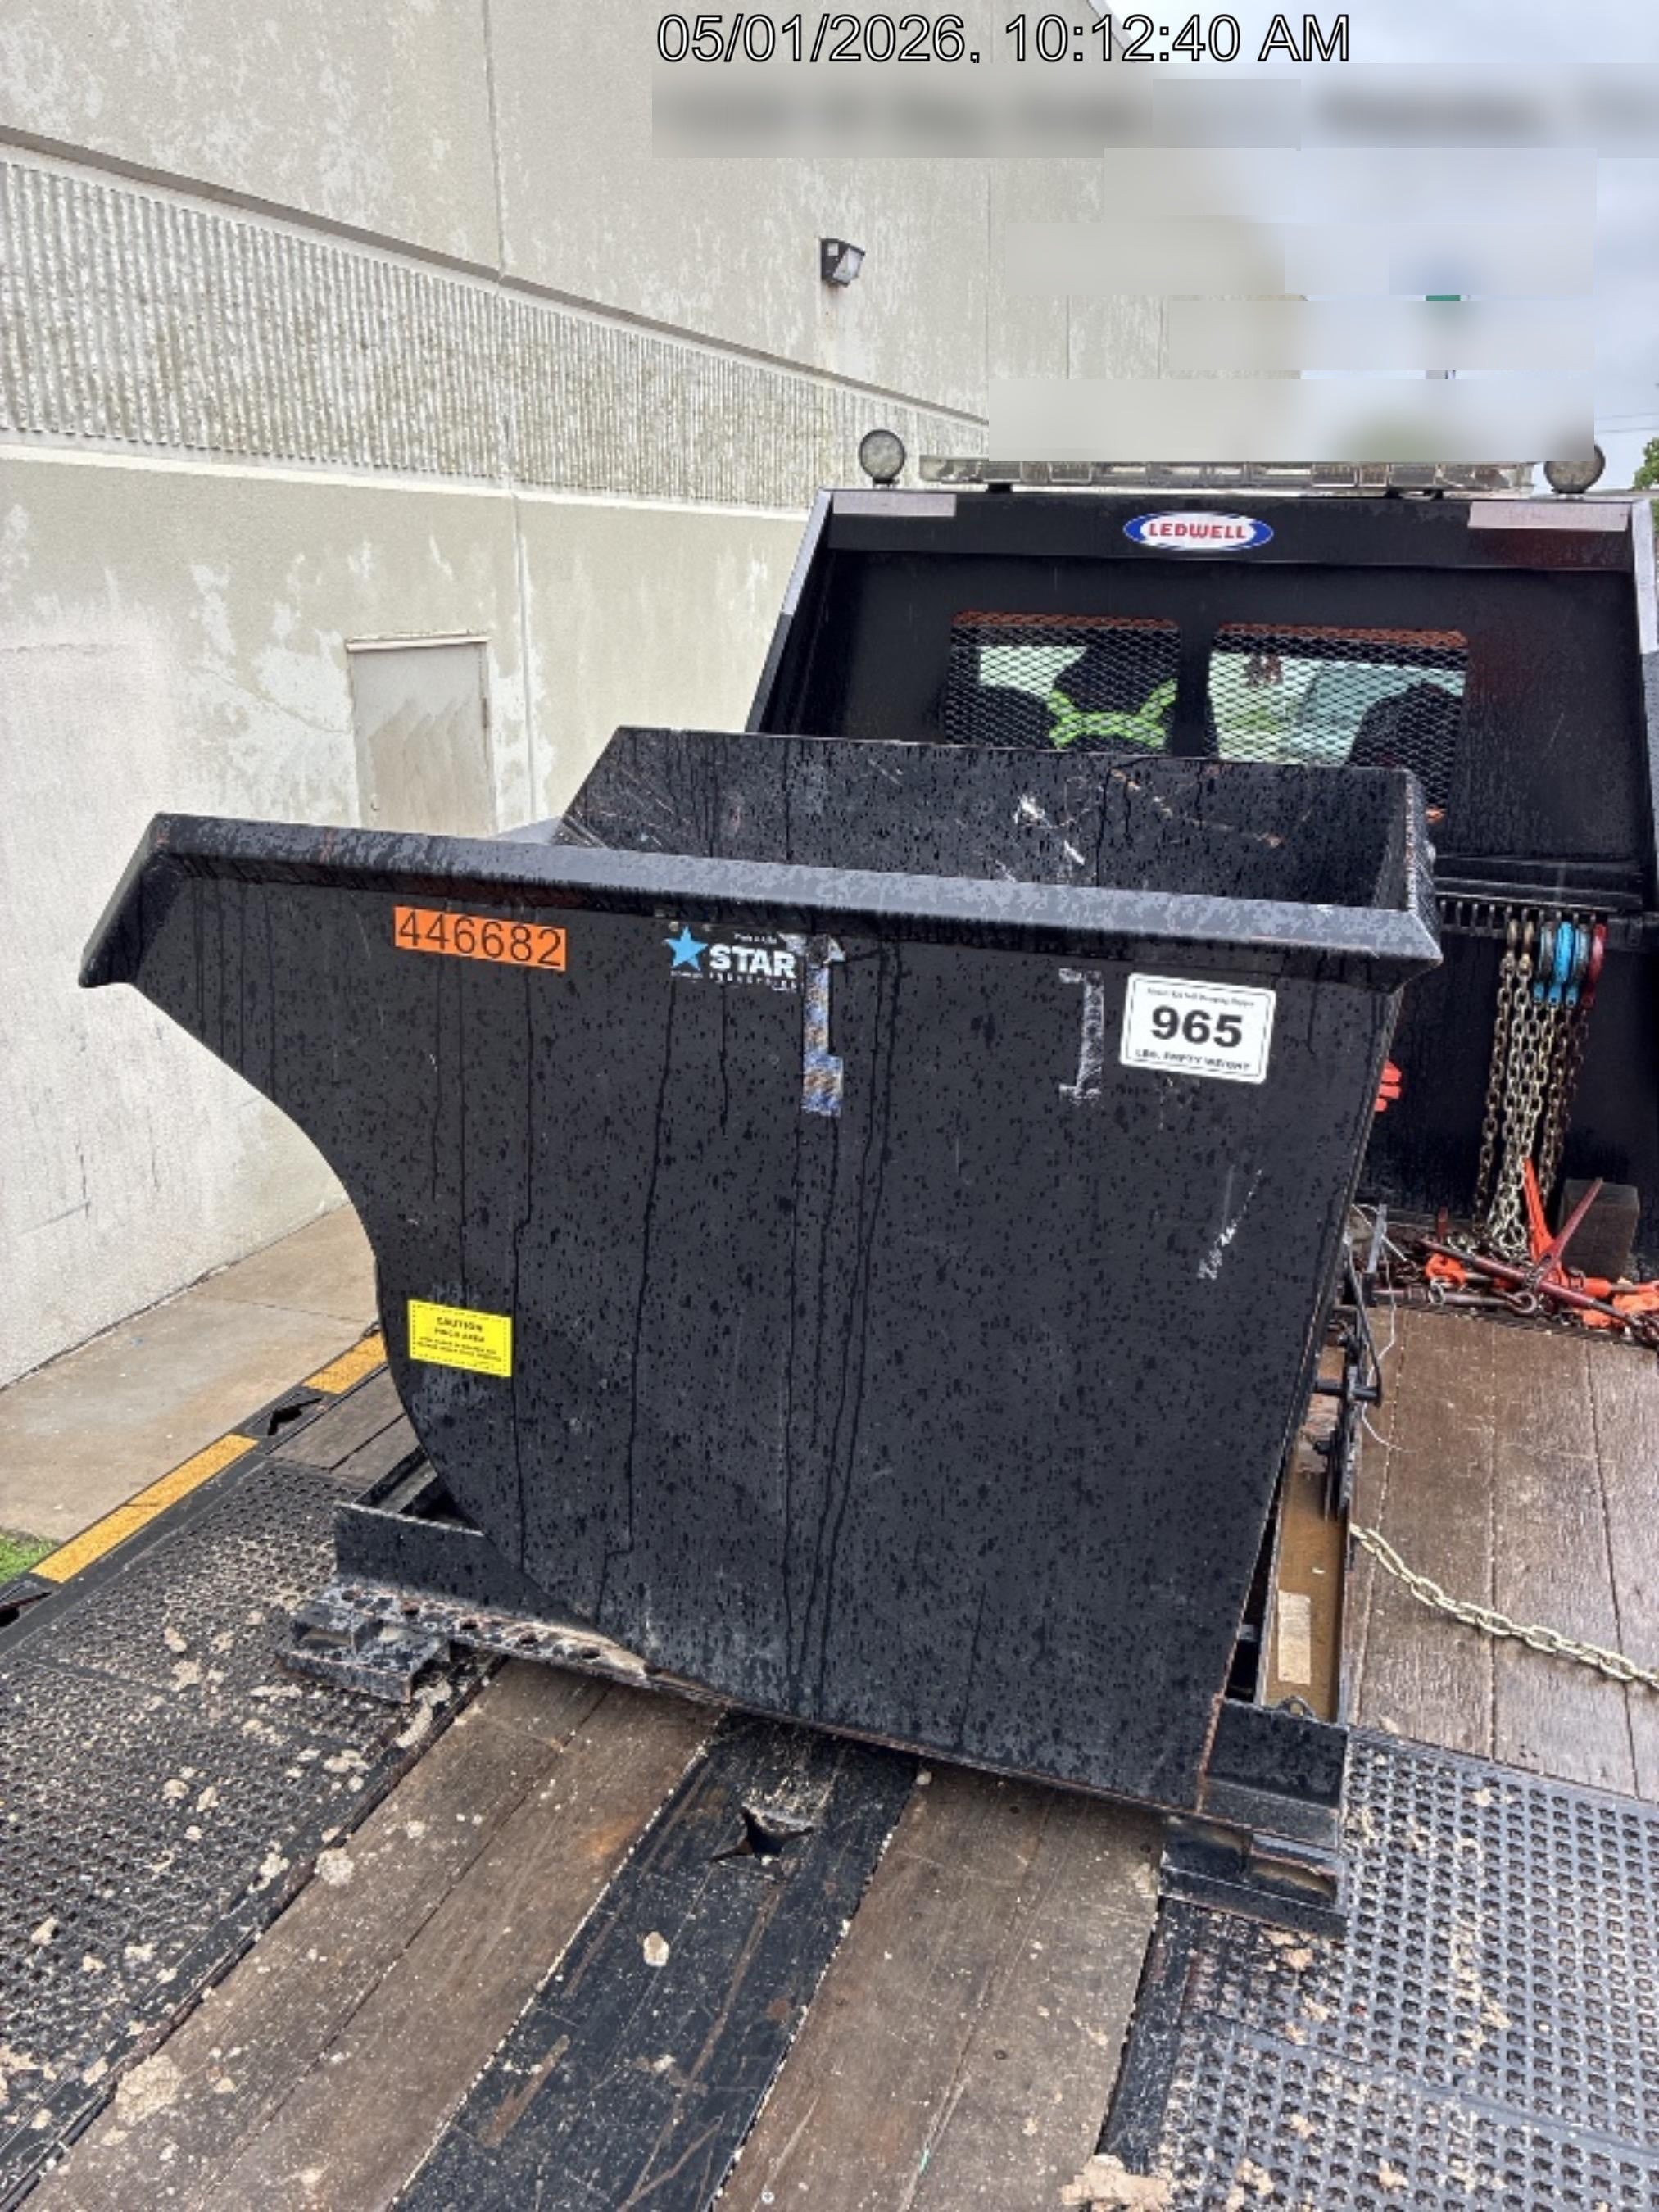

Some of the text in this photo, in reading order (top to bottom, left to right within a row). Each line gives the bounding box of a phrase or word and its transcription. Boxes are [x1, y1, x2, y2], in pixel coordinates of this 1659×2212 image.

[1149, 523, 1246, 539] LEDWELL
[399, 909, 562, 968] 446682
[709, 943, 798, 978] STAR
[1150, 1005, 1243, 1048] 965
[436, 1317, 483, 1332] CAUTION
